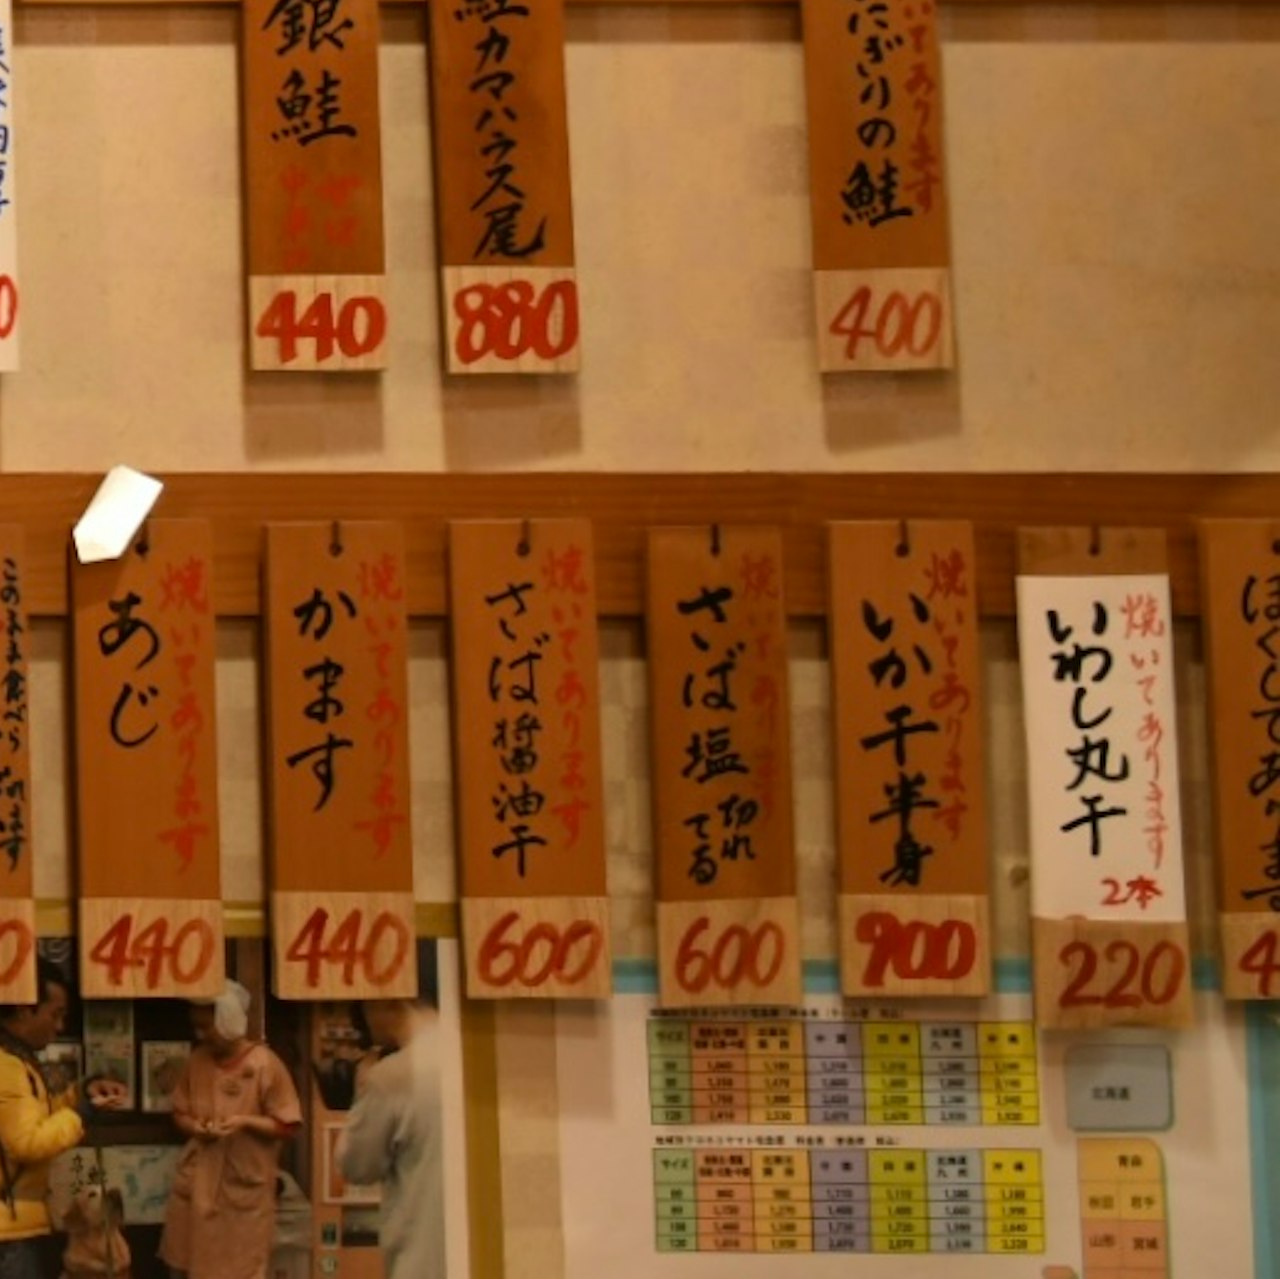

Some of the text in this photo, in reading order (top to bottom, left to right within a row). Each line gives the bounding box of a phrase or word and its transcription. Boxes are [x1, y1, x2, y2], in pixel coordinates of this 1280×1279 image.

[256, 291, 386, 362] 440
[455, 280, 579, 363] 880
[830, 286, 938, 360] 400
[97, 590, 162, 750] あじ
[284, 586, 360, 813] かます
[484, 581, 551, 880] さば醤油干
[1046, 602, 1130, 857] いわし丸干
[1101, 875, 1162, 907] 2本
[90, 913, 215, 988] 440
[285, 906, 412, 987] 440
[477, 911, 603, 988] 600
[676, 917, 785, 993] 600
[856, 911, 977, 988] 900
[1057, 940, 1186, 1009] 220
